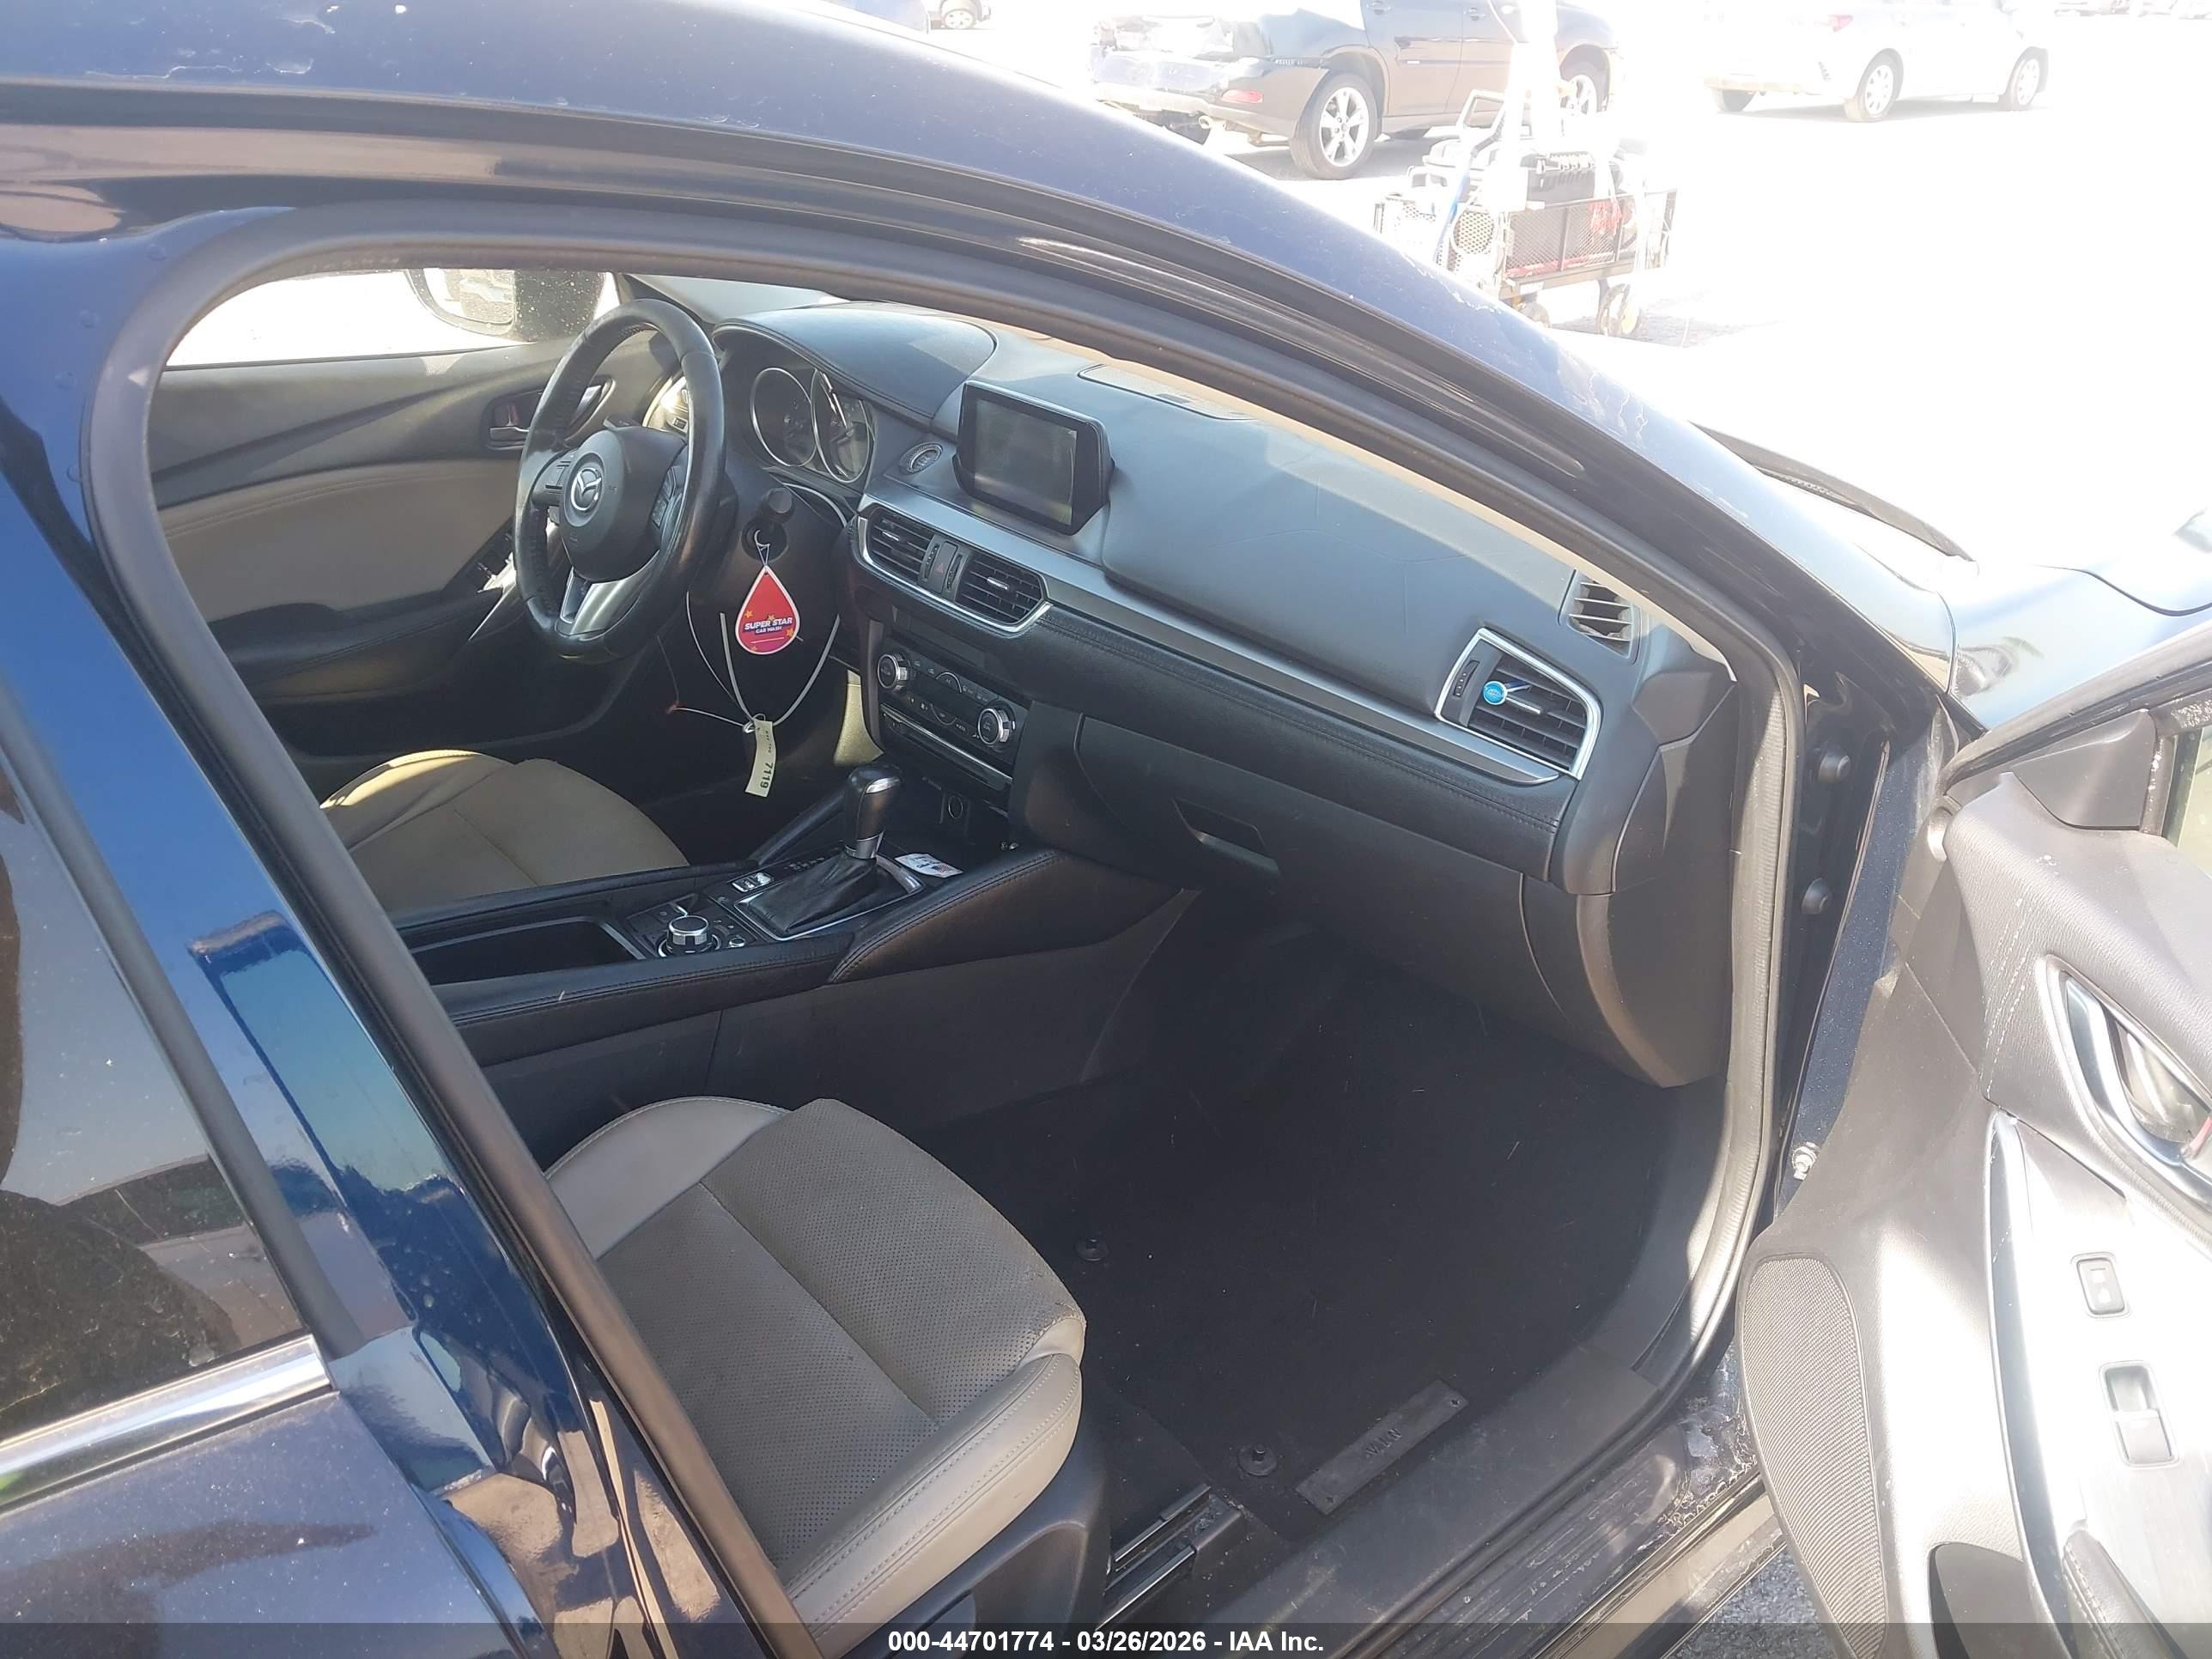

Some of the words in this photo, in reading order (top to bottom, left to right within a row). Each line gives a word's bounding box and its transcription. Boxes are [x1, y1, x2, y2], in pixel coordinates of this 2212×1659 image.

[744, 620, 771, 630] SUPER
[772, 617, 793, 627] STAR
[760, 762, 774, 788] 7119
